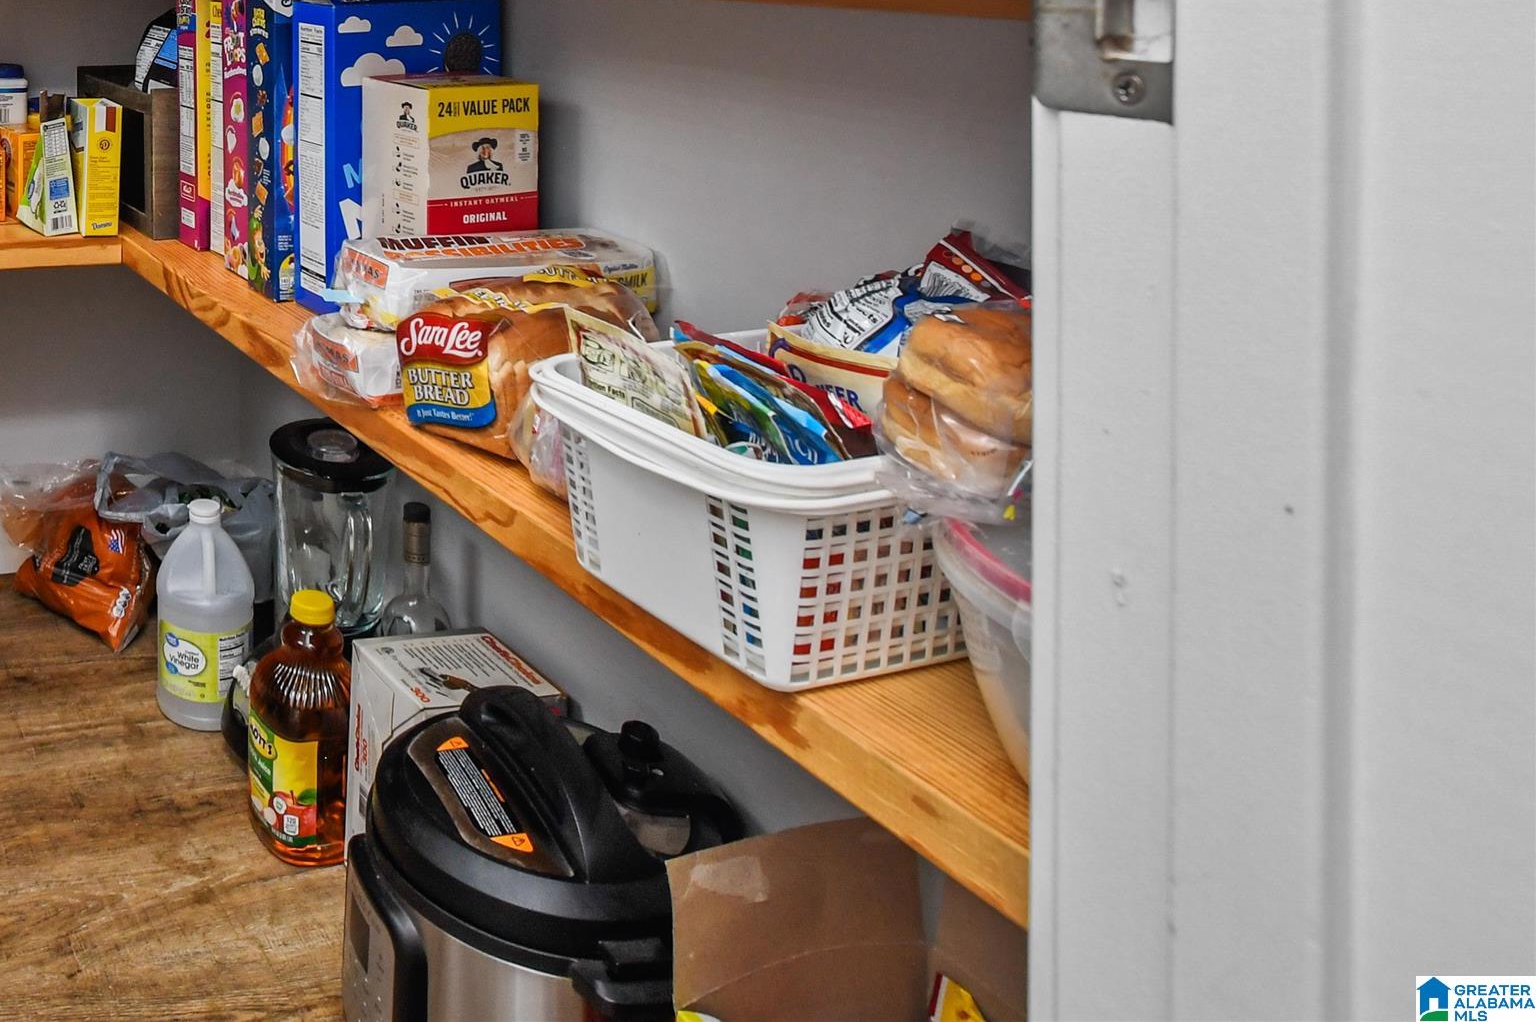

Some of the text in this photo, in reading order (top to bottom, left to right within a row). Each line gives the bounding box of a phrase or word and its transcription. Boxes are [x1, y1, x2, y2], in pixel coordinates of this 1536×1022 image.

[437, 97, 531, 118] 24 VALUE PACK
[396, 120, 418, 131] QUAKER
[460, 171, 510, 190] QUAKER
[450, 196, 519, 208] INSTANT OATMEAL
[462, 210, 508, 225] ORIGINAL
[376, 233, 491, 253] MUFFIN
[399, 317, 484, 359] Sara Lee
[407, 367, 474, 390] BUTTER
[413, 383, 470, 406] BREAD
[422, 409, 432, 420] Just
[432, 408, 451, 420] Tastes
[169, 653, 200, 671] Vinegar
[176, 650, 200, 664] White
